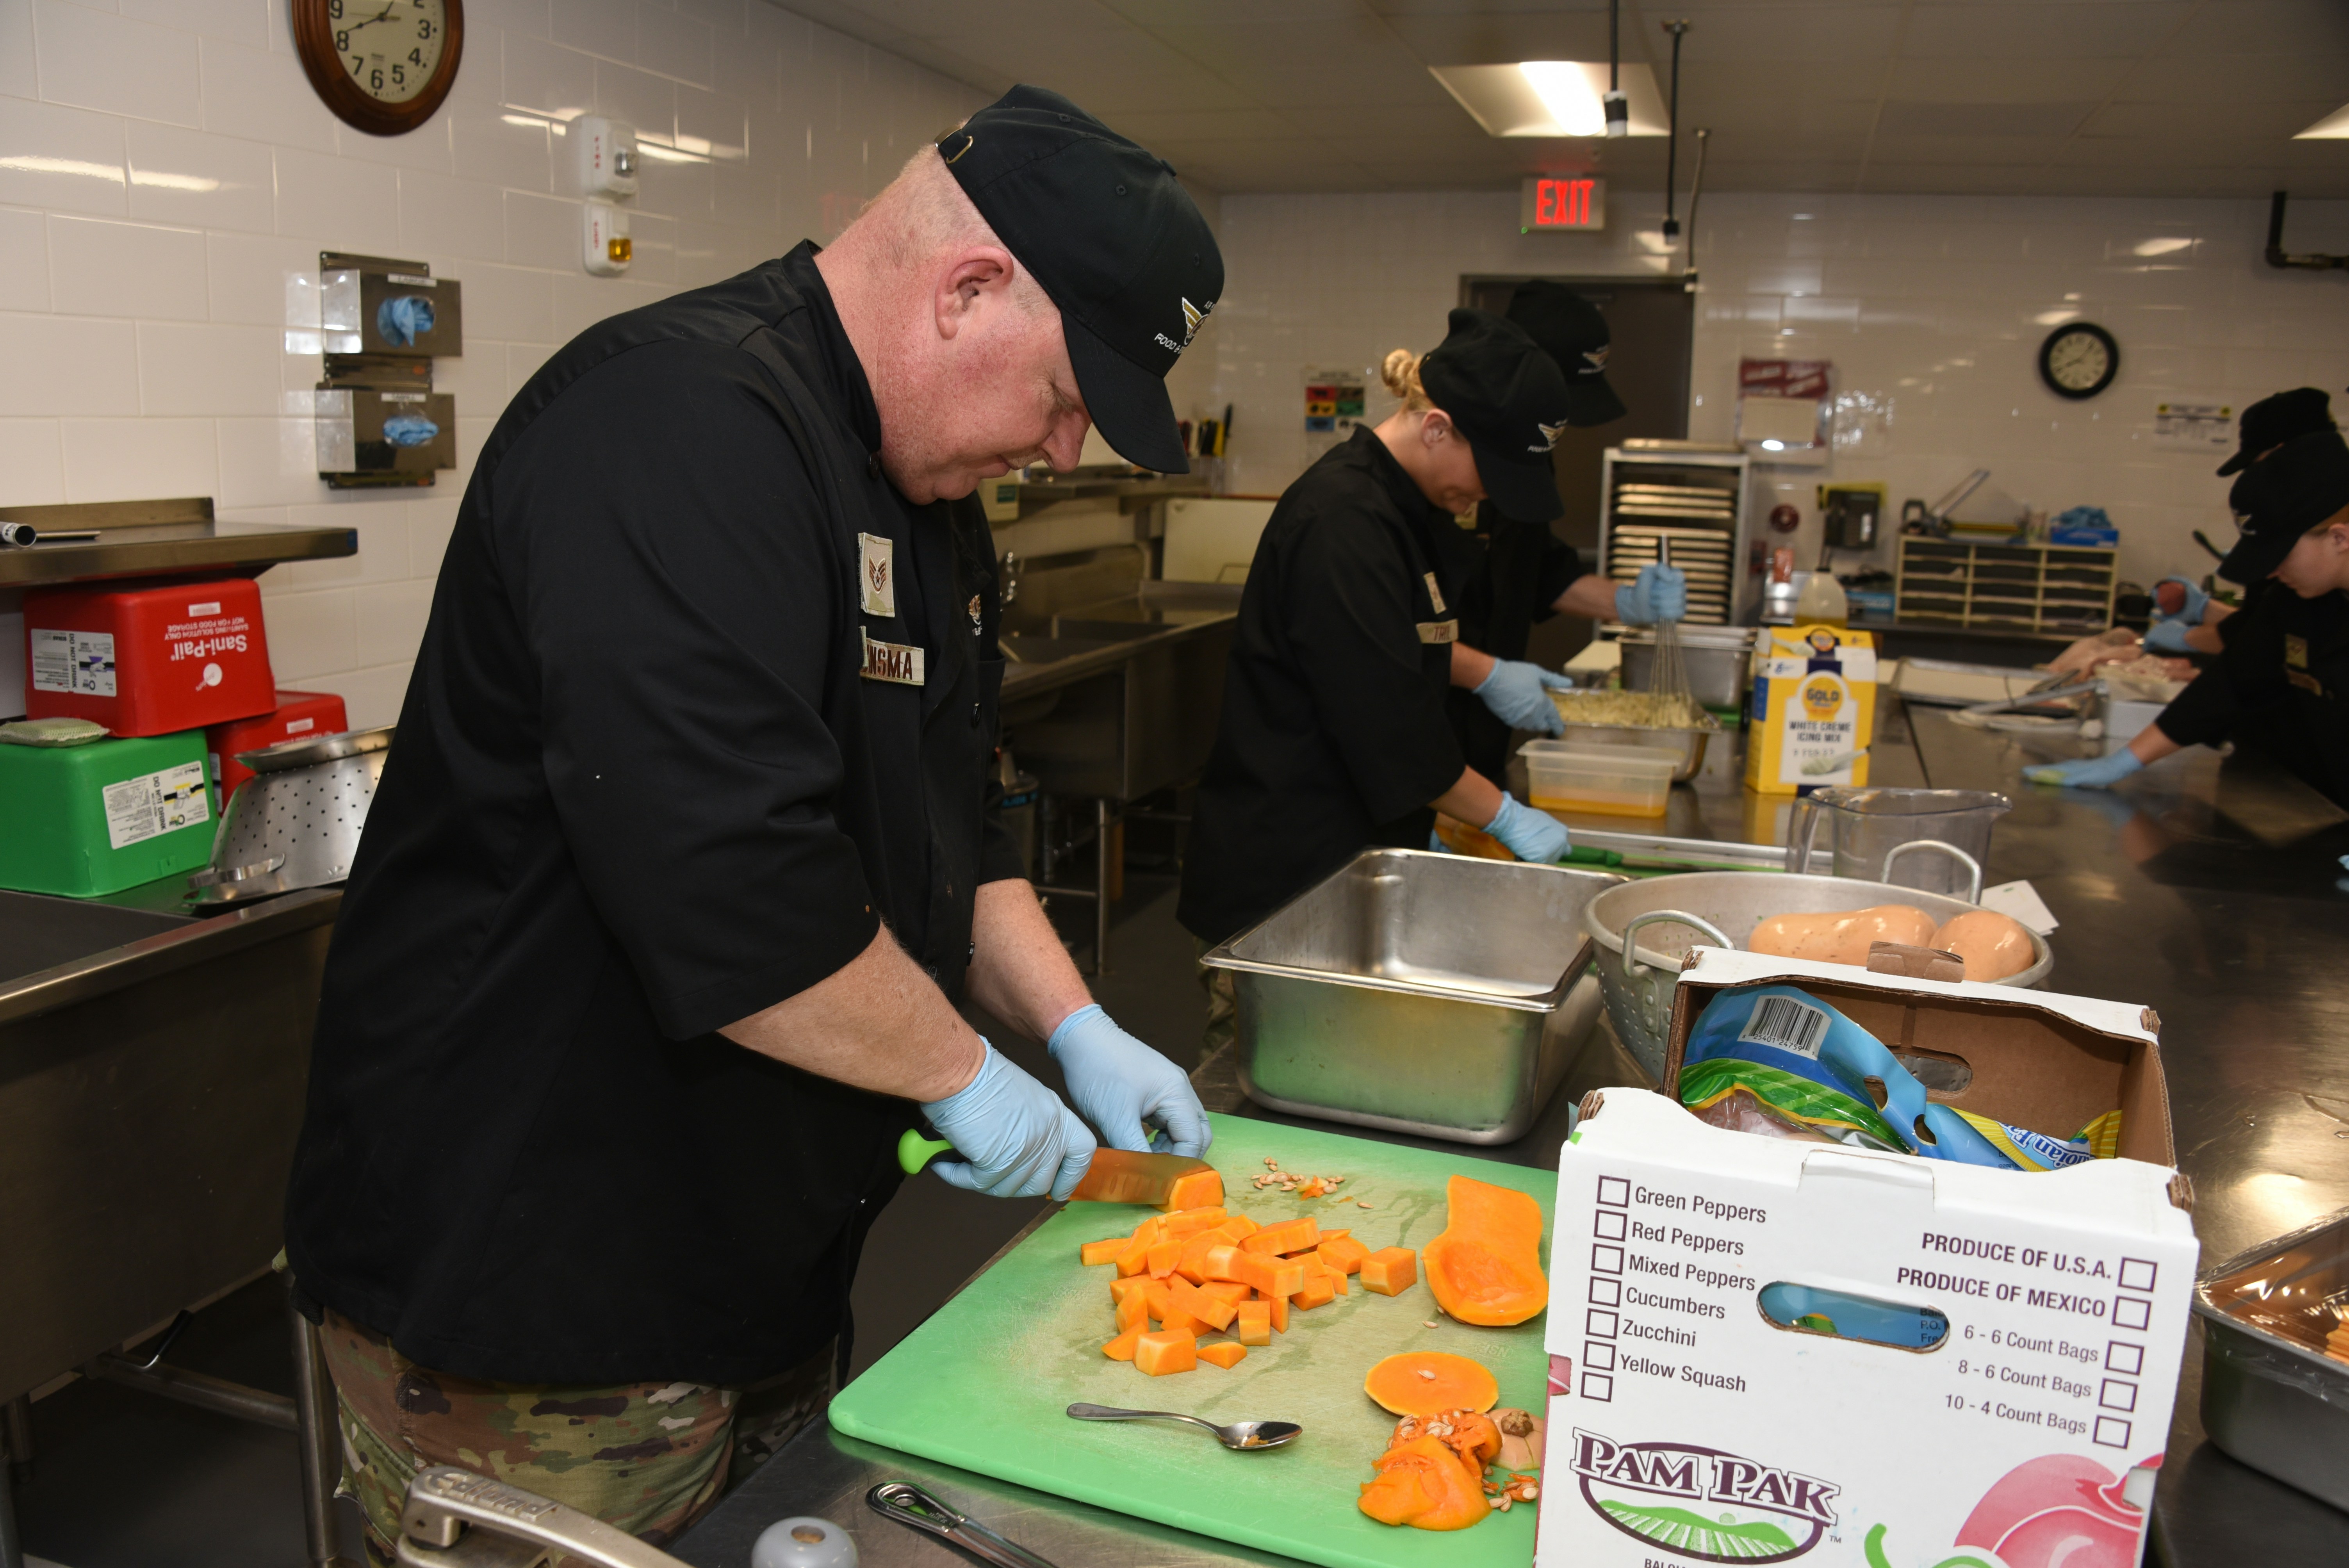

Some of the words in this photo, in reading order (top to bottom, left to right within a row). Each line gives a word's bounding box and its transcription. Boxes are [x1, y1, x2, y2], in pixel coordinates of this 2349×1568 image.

[336, 31, 349, 52] 8
[418, 19, 430, 39] 3
[352, 56, 364, 75] 7
[408, 48, 421, 66] 4
[371, 69, 383, 90] 6
[392, 64, 405, 84] 5
[1536, 179, 1595, 225] EXIT
[1806, 688, 1839, 702] GOLD
[1789, 721, 1817, 731] WHITE
[1821, 721, 1851, 733] CREME
[1797, 732, 1821, 743] ICING
[1825, 733, 1841, 743] MIX
[1753, 1034, 1775, 1044] 25401
[1779, 1039, 1802, 1051] 24759
[1635, 1186, 1686, 1210] Green
[1692, 1195, 1766, 1224] Peppers
[1632, 1222, 1665, 1243] Red
[1671, 1228, 1744, 1256] Peppers
[1921, 1232, 2015, 1263] PRODUCE
[2021, 1249, 2048, 1267] OF
[2053, 1254, 2112, 1280] U.S.A.
[1629, 1255, 1679, 1278] Mixed
[1685, 1265, 1756, 1291] Peppers
[1626, 1287, 1725, 1320] Cucumbers
[1897, 1267, 1989, 1298] PRODUCE
[1996, 1283, 2022, 1302] OF
[2027, 1290, 2106, 1318] MEXICO
[1622, 1319, 1697, 1347] Zucchini
[1921, 1320, 1940, 1330] P.O.
[1964, 1325, 1974, 1340] 6
[1991, 1329, 2001, 1345] 6
[2006, 1331, 2053, 1354] Count
[2058, 1340, 2099, 1364] Bags
[1621, 1354, 1675, 1379] Yellow
[1681, 1366, 1746, 1392] Squash
[1958, 1360, 1968, 1374] 8
[1985, 1364, 1995, 1379] 6
[2000, 1367, 2047, 1389] Count
[2052, 1376, 2092, 1398] Bags
[1945, 1393, 1964, 1410] 10
[1980, 1400, 1991, 1415] 4
[1995, 1402, 2042, 1425] Count
[2046, 1411, 2087, 1435] Bags
[1569, 1426, 1702, 1500] PAM
[1708, 1454, 1841, 1526] PAK
